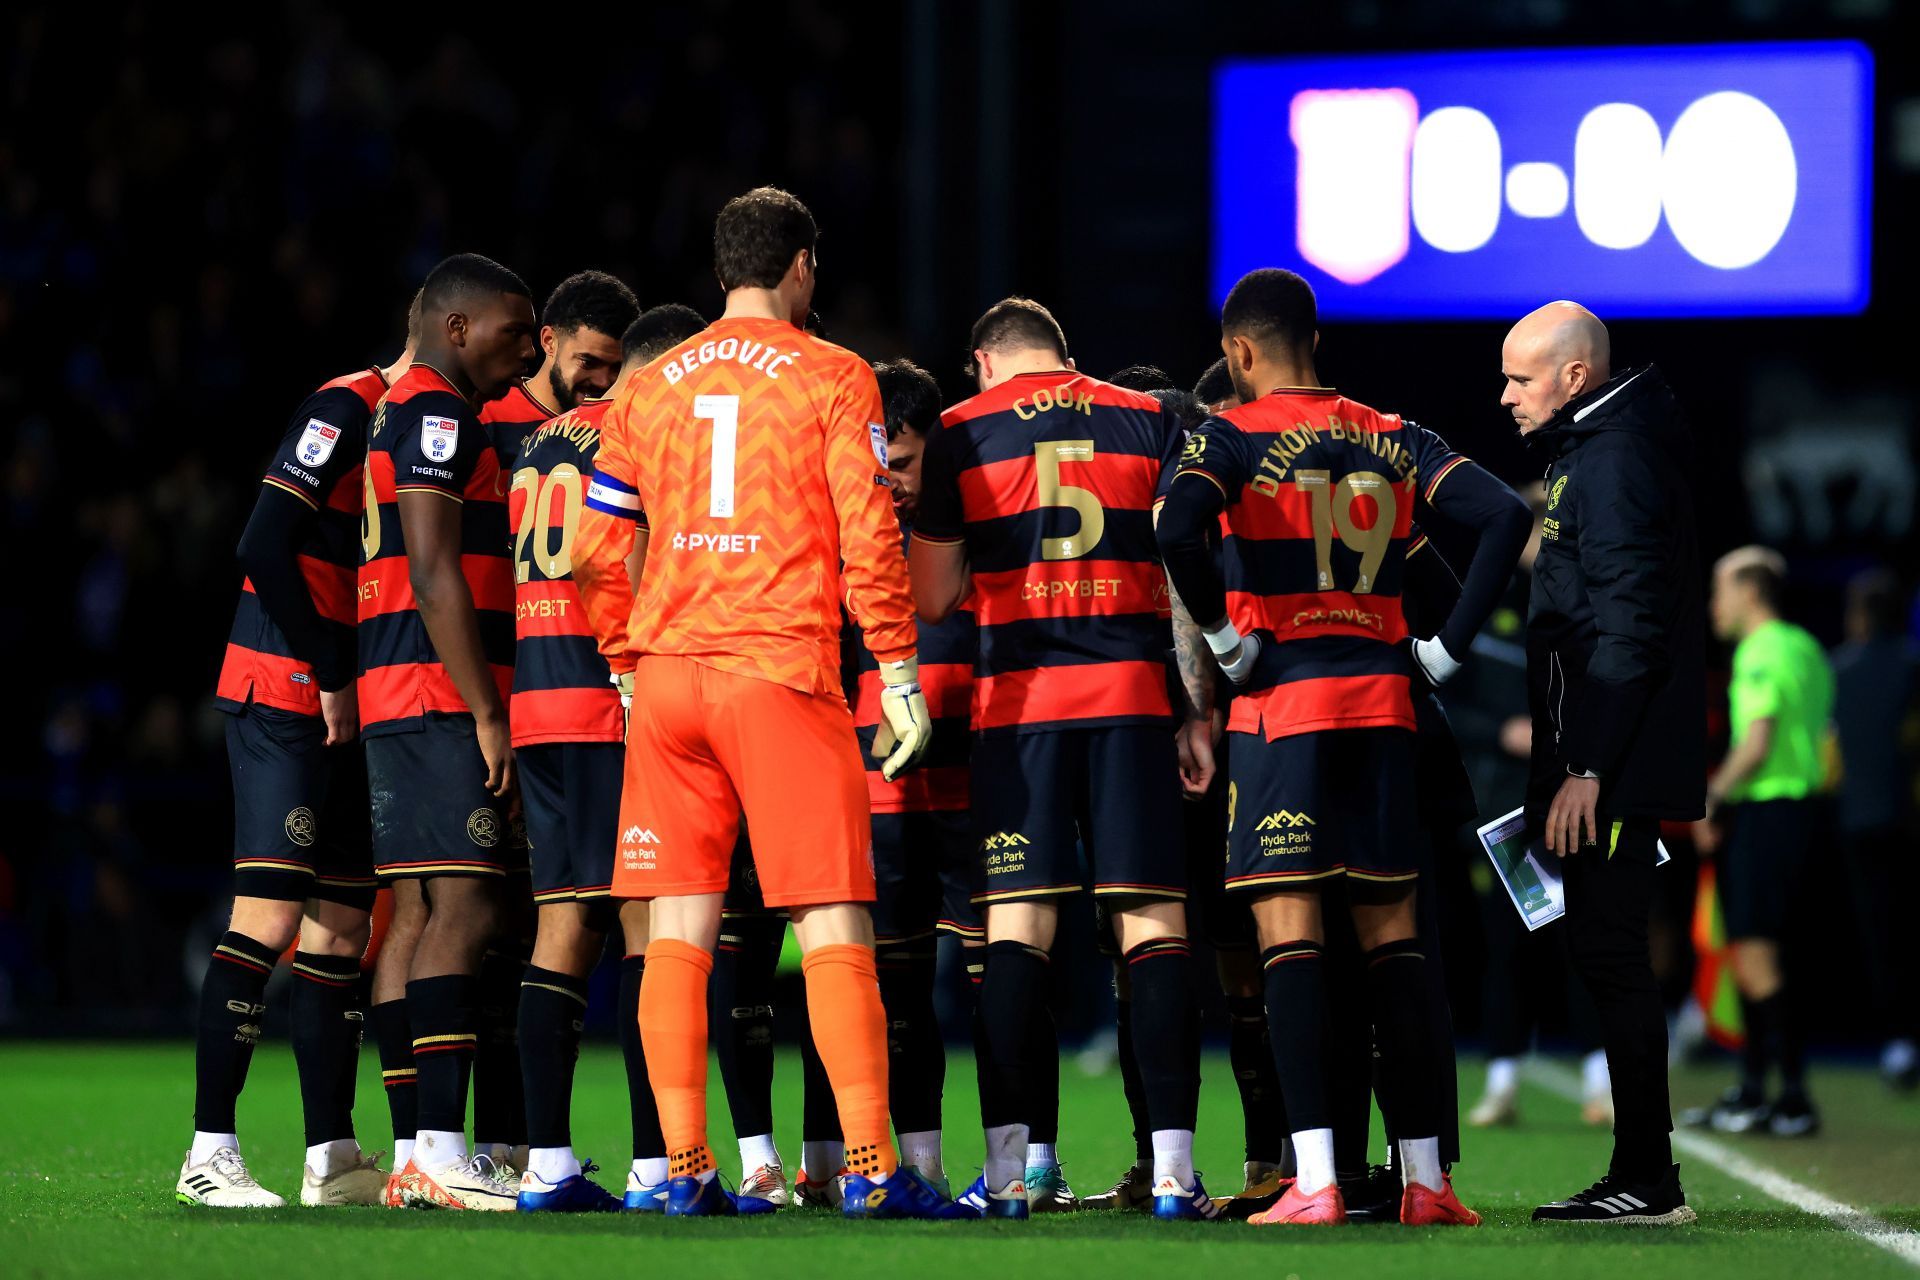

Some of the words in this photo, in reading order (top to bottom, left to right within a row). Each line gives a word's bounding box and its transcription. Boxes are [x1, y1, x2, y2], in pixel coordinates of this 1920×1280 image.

[662, 338, 801, 385] BEGOVIĆ
[1012, 387, 1095, 421] COOK
[310, 424, 321, 432] sky
[322, 427, 334, 438] bet
[426, 420, 439, 428] sky
[524, 415, 600, 458] CANNON
[304, 454, 315, 463] EFL
[694, 395, 739, 517] 1
[1034, 440, 1104, 560] 5
[511, 463, 583, 585] 20
[1294, 469, 1397, 594] 19
[1021, 579, 1121, 600] COPYBET
[1260, 834, 1286, 848] Hyde
[1288, 831, 1312, 843] Park
[623, 849, 637, 861] Hyde
[639, 849, 656, 860] Park
[1004, 850, 1025, 862] Park
[1264, 845, 1312, 857] Construction
